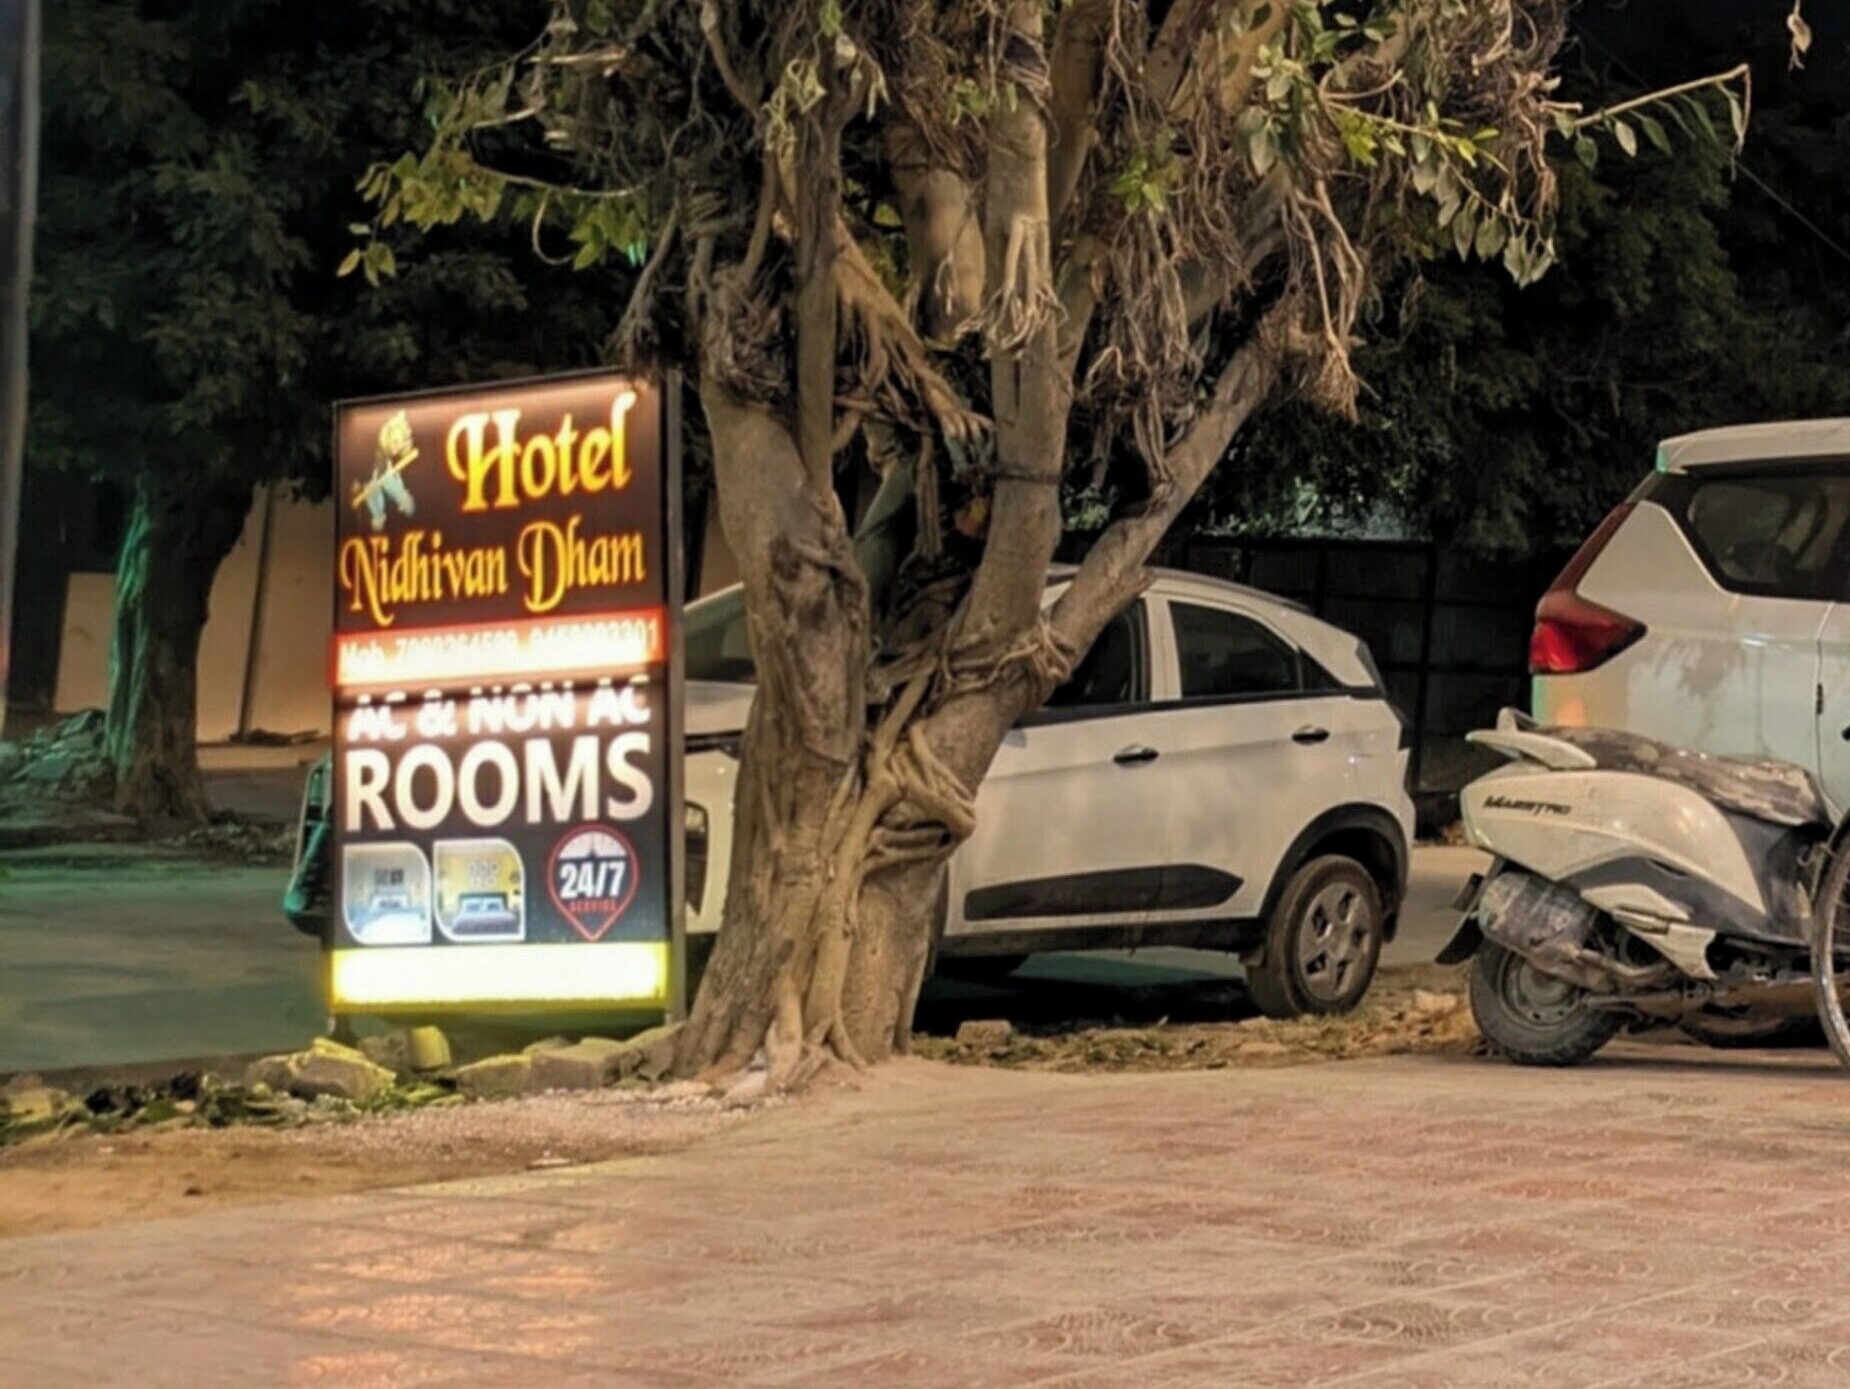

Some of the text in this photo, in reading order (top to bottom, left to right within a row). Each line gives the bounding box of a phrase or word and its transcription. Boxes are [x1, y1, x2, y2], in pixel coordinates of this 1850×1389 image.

[446, 391, 637, 511] Hotel
[340, 514, 646, 626] Nidhivan Dham
[346, 673, 650, 742] AC & NON AC
[346, 731, 654, 832] ROOMS
[559, 859, 626, 900] 24/7
